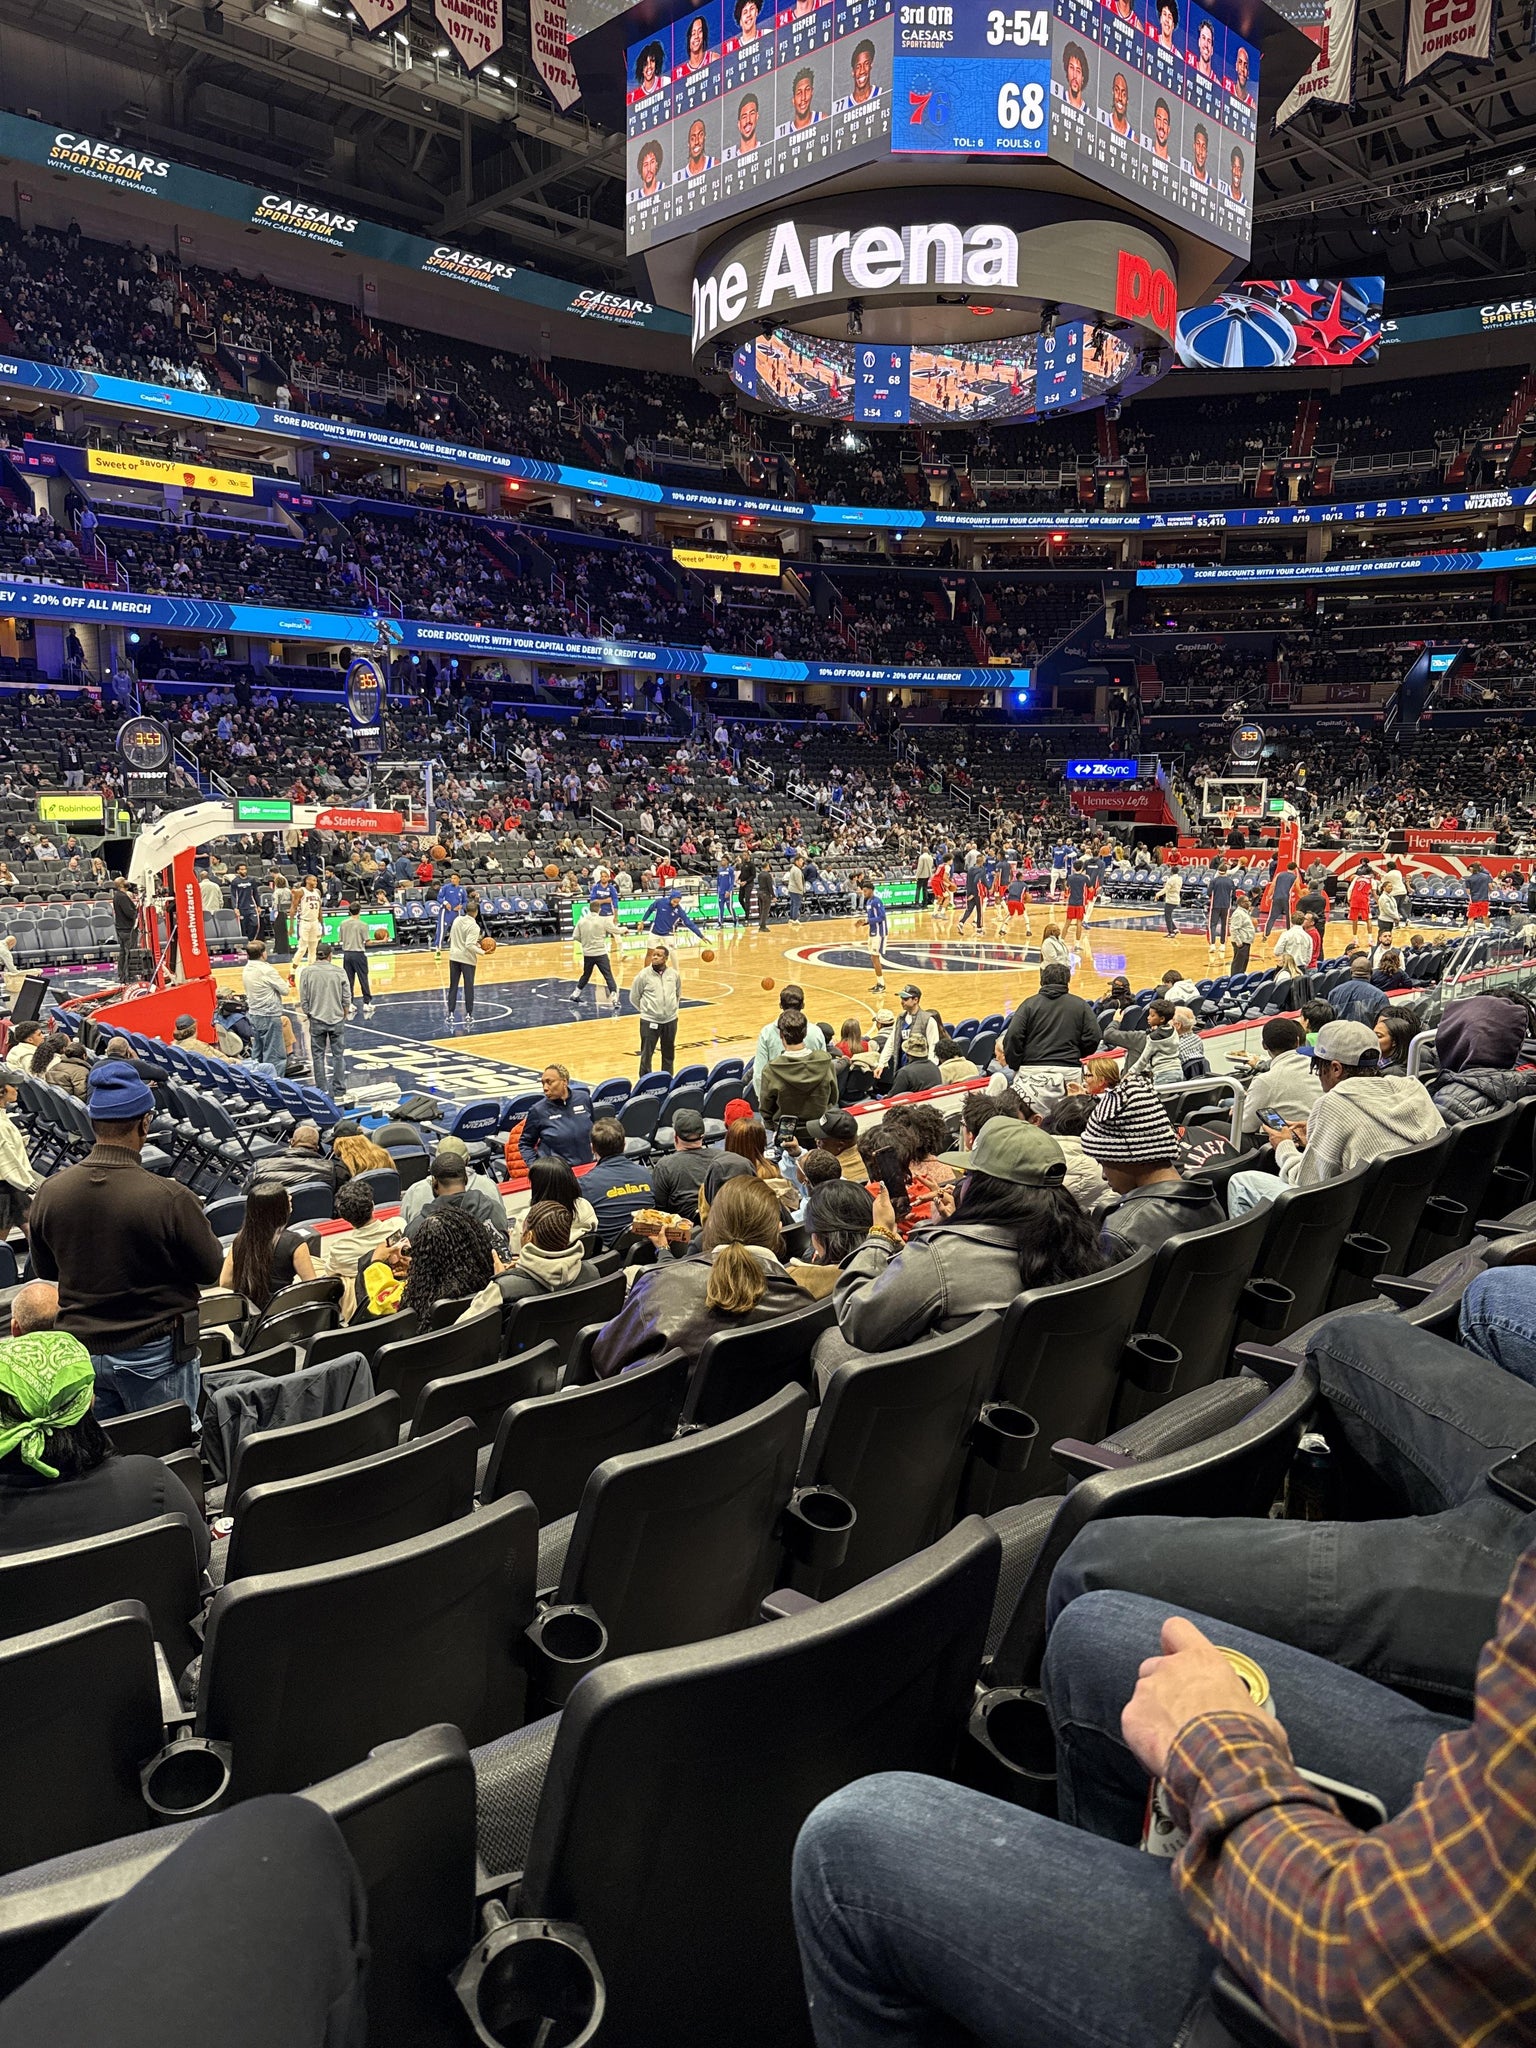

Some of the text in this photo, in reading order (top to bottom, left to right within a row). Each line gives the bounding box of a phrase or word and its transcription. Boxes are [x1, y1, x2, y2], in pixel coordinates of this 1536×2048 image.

[441, 0, 496, 29] CHAMPIONS
[780, 13, 788, 26] 24
[839, 2, 890, 35] 4 2 2 0
[822, 19, 831, 30] FLS
[901, 6, 1048, 46] 3rd QTR 3:54
[448, 18, 491, 52] 1977-78
[809, 31, 829, 49] 0 0
[902, 30, 953, 41] CAESARS
[902, 40, 944, 48] SPORTSBOOK
[1421, 24, 1476, 55] JOHNSON
[537, 39, 571, 64] CHAMPI
[1298, 75, 1329, 96] HAYES
[836, 99, 844, 111] 77
[844, 100, 880, 123] EDGECOMBE
[909, 91, 948, 126] 76
[997, 82, 1044, 129] 68
[779, 125, 786, 136] 11
[835, 108, 890, 138] PTS FLS
[821, 133, 829, 144] FLS
[837, 121, 888, 150] 7 2 2
[953, 138, 984, 147] TOL: 6
[997, 139, 1040, 148] FOULS: 0
[50, 146, 145, 181] SPORTSBOOK
[55, 133, 170, 177] CAESARS
[47, 159, 158, 194] WITH CAESARS REWARDS
[255, 206, 335, 236] SPORTSBOOK
[262, 195, 358, 232] CAESARS
[251, 217, 271, 227] WITH
[272, 223, 306, 237] CAESARS
[426, 256, 495, 282] SPORTSBOOK
[433, 247, 516, 279] CAESARS
[754, 220, 1019, 309] Arena
[421, 265, 439, 274] WITH
[440, 271, 468, 282] CAESARS
[571, 299, 636, 318] SPORTSBOOK
[579, 290, 654, 313] CAESARS
[1480, 300, 1536, 316] CAES
[1044, 360, 1054, 370] 72
[1066, 353, 1076, 364] 68
[862, 374, 901, 385] 72 68
[1044, 394, 1060, 405] 3:54
[863, 408, 881, 417] 3:54
[274, 414, 511, 466] SCORE DISCOUNTS WITH YOUR CAPITAL ONE DEBIT OR CREDIT CARD
[95, 457, 176, 470] Sweet or savory?
[672, 492, 685, 500] 10%
[699, 496, 717, 505] FOOD
[744, 501, 757, 509] 20%
[771, 504, 782, 512] ALL
[783, 506, 805, 515] MERCH
[1464, 497, 1513, 510] WIZARDS
[1470, 492, 1508, 500] WASHINGTON
[1197, 517, 1227, 527] $5,410
[1292, 515, 1310, 523] 8/19
[1321, 513, 1343, 521] 10/12
[1356, 510, 1364, 518] 18
[677, 555, 697, 563] Sweet
[1217, 569, 1255, 577] DISCOUNTS
[1297, 565, 1324, 574] CAPITAL
[1340, 563, 1362, 572] DEBIT
[1374, 561, 1400, 570] CREDIT
[1401, 560, 1421, 568] CARD
[33, 594, 151, 614] 20% OFF ALL MERCH
[417, 629, 444, 640] SCORE
[446, 631, 490, 644] DISCOUNTS
[492, 636, 512, 646] WITH
[513, 639, 534, 648] YOUR
[535, 641, 564, 651] CAPITAL
[566, 644, 580, 652] ONE
[582, 645, 602, 654] DEBIT
[603, 648, 613, 656] OR
[614, 649, 638, 658] CREDIT
[639, 652, 656, 660] CARD
[136, 732, 161, 746] 3:53
[361, 726, 380, 736] TISSOT
[1092, 764, 1129, 777] ZKsync
[58, 804, 102, 813] Robinhood
[1082, 795, 1149, 807] Hennessy Lofts
[187, 883, 201, 956] @washwizards
[606, 1183, 650, 1198] dallara
